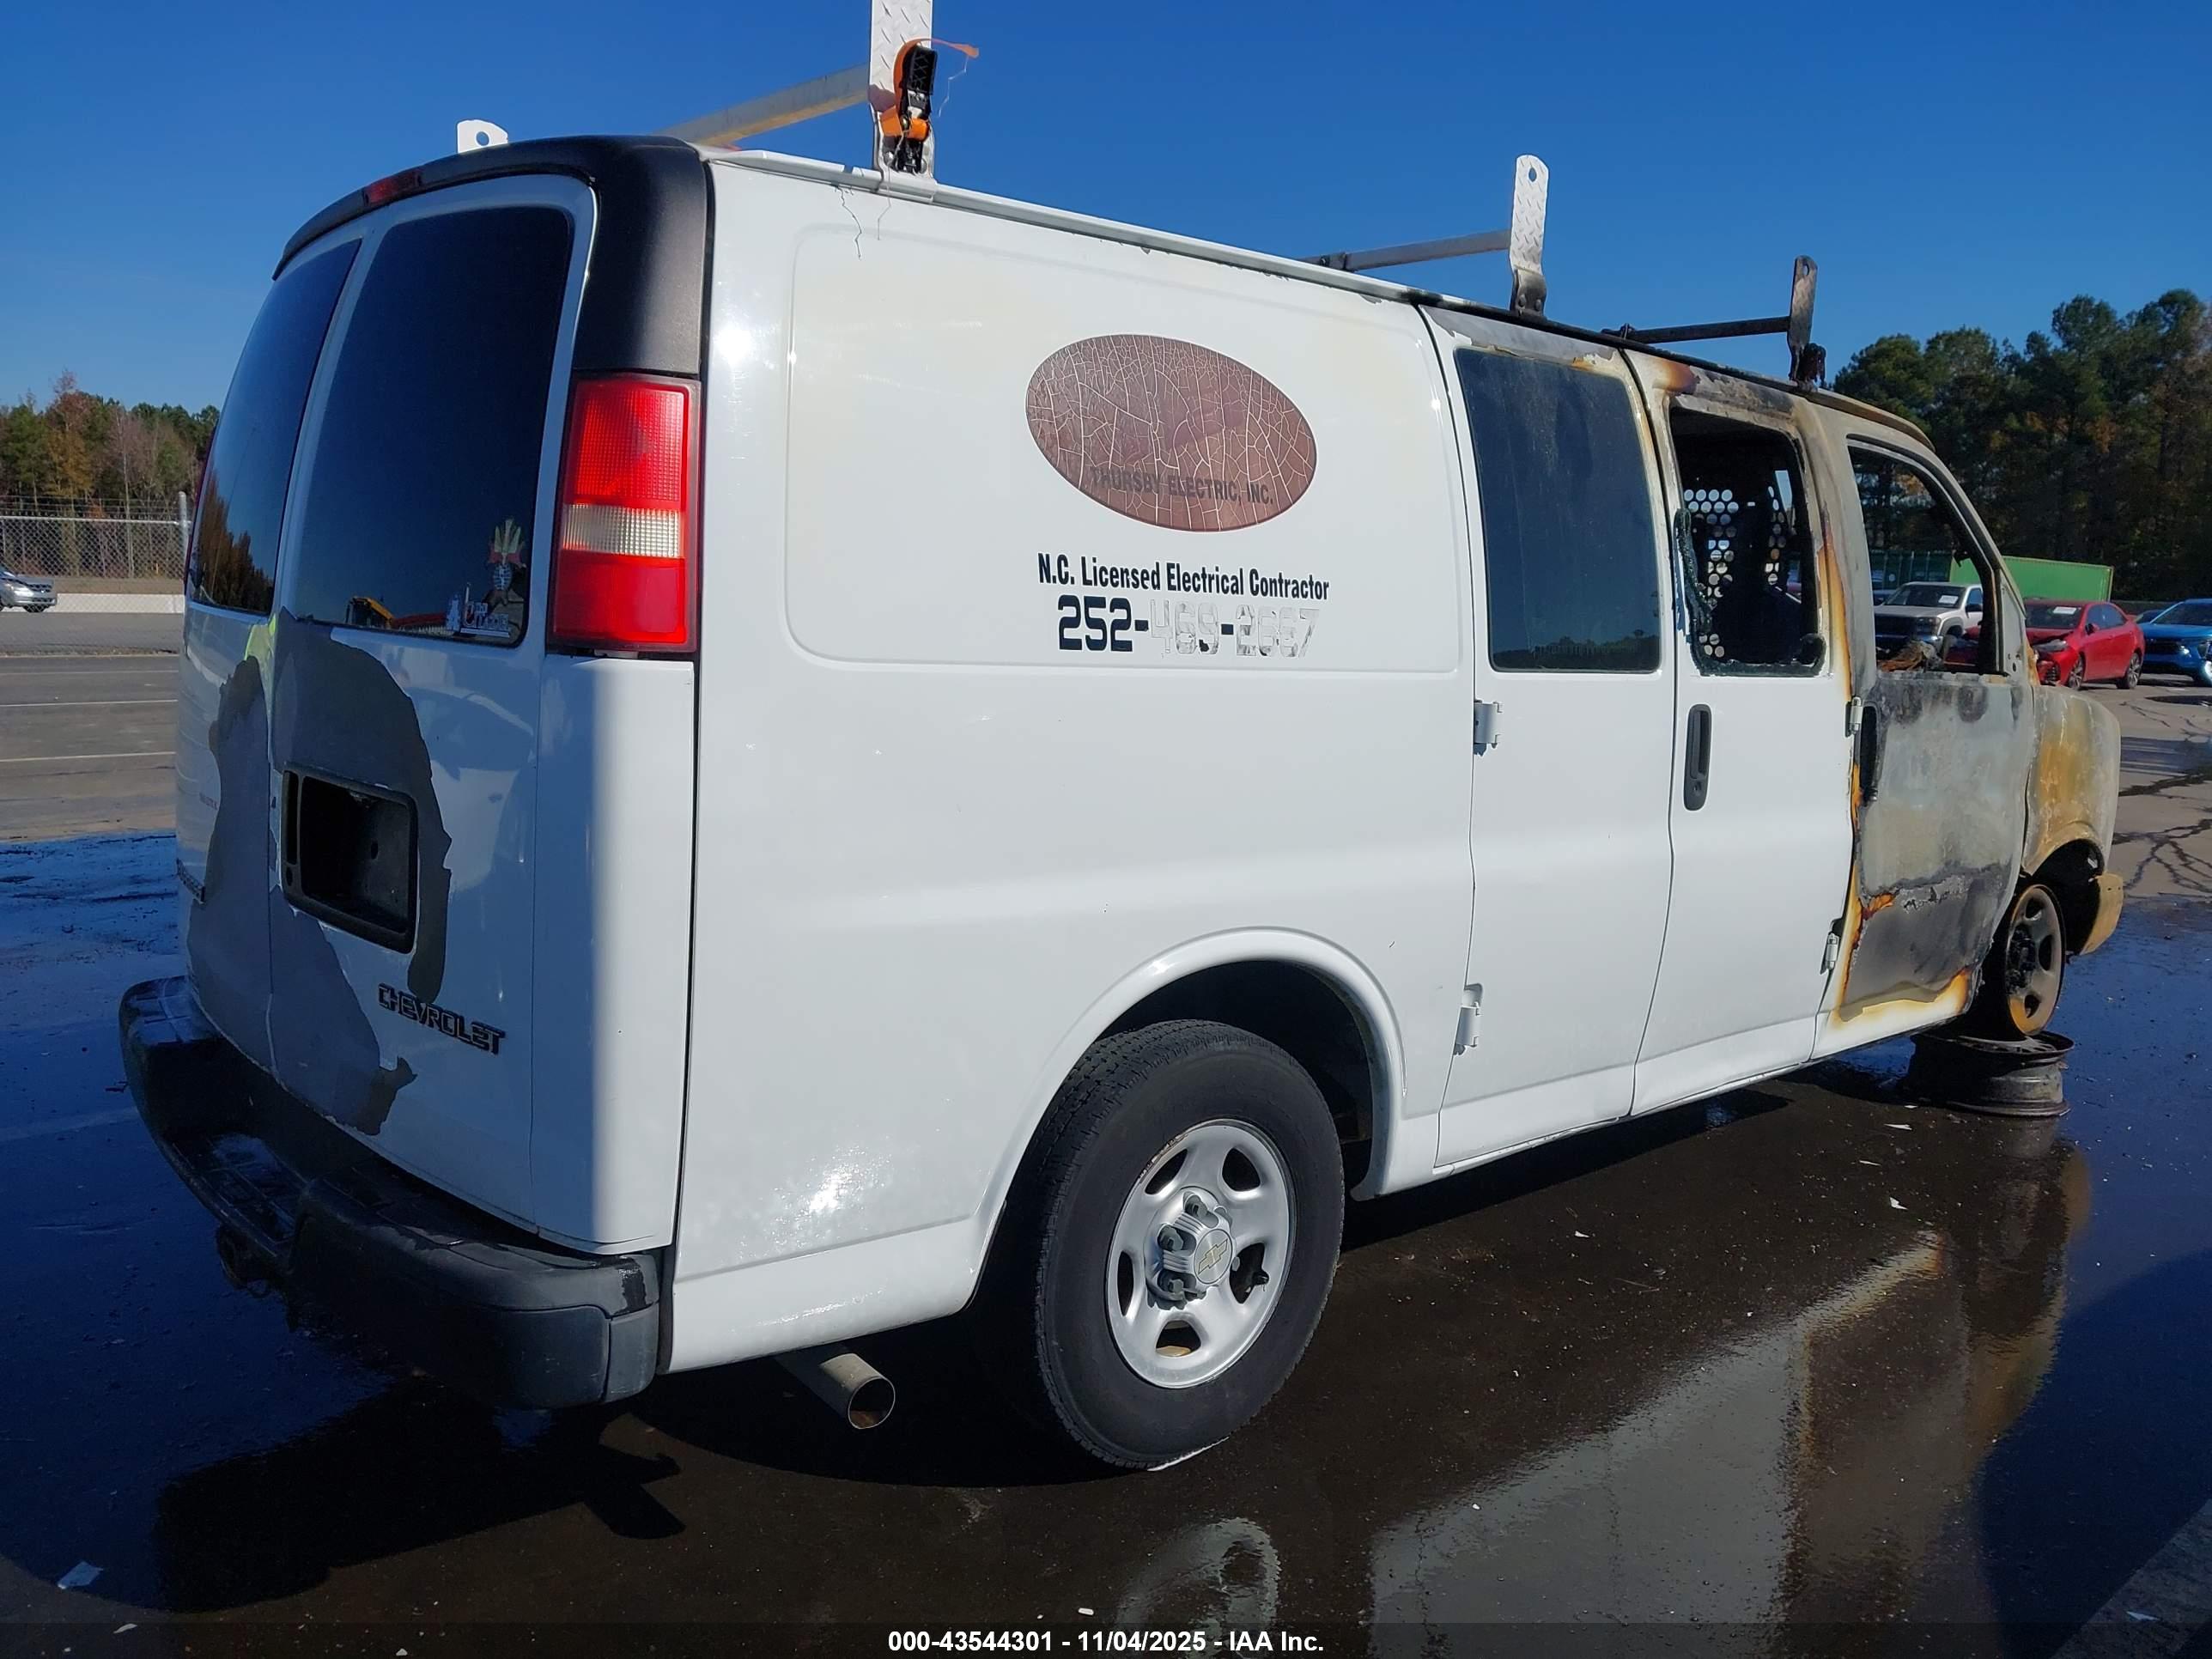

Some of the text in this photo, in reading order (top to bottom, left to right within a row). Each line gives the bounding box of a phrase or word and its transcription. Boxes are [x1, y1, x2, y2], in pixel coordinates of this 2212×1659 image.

[1168, 475, 1242, 505] ELECTRIC,
[1247, 483, 1273, 505] INC.
[1037, 552, 1329, 600] N.C. Licensed Electrical Contractor
[378, 982, 505, 1055] CHEVROLET
